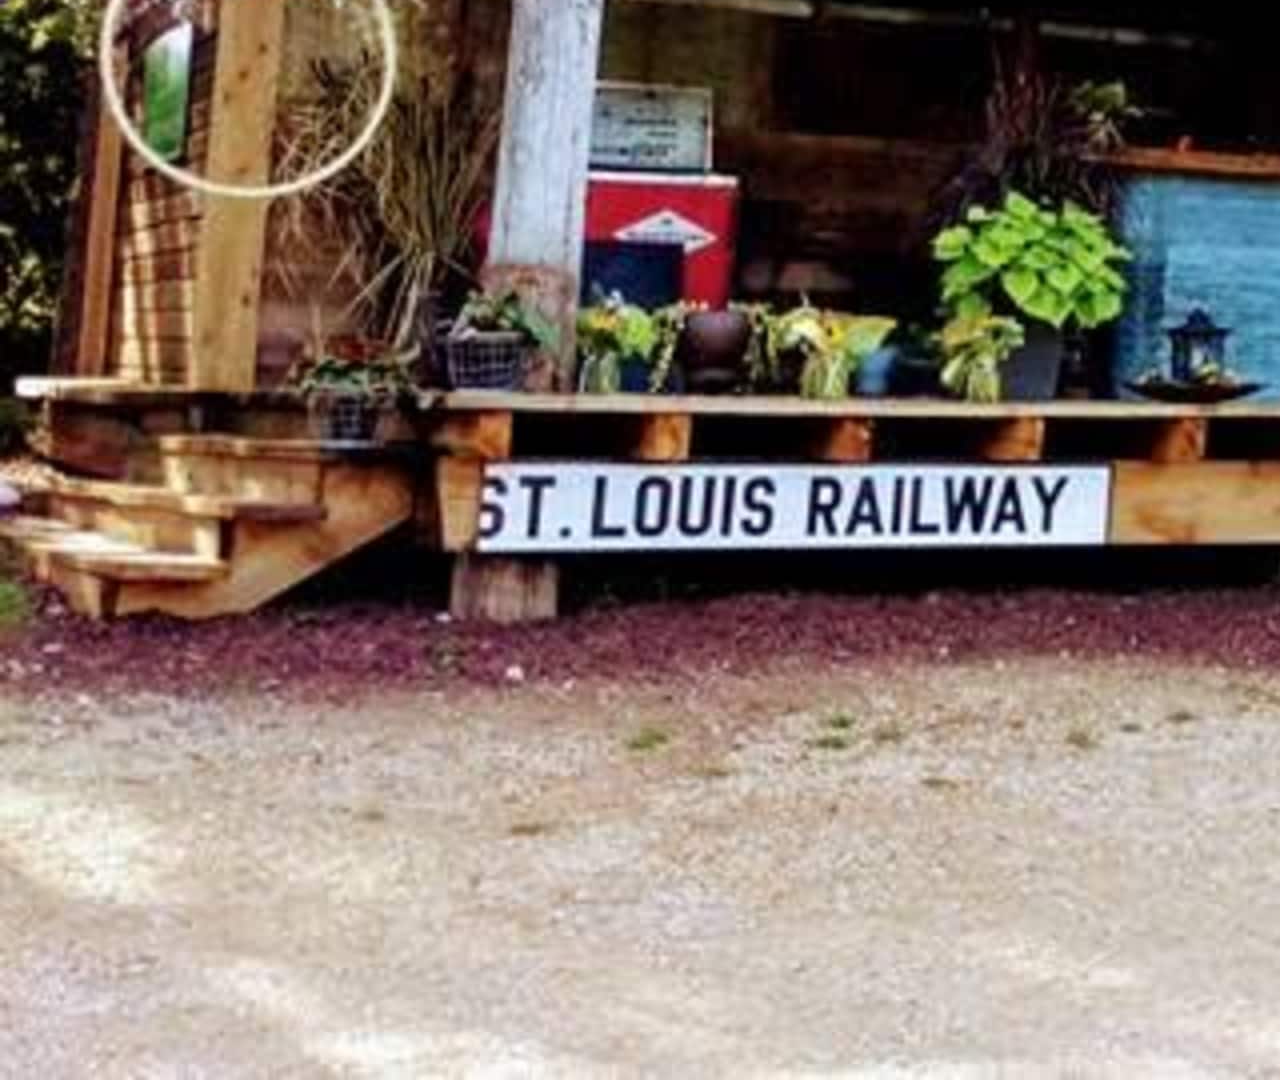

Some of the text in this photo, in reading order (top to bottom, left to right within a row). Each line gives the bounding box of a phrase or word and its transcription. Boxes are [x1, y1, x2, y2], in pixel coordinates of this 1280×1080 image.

[480, 475, 1070, 539] ST. LOUIS RAILWAY
